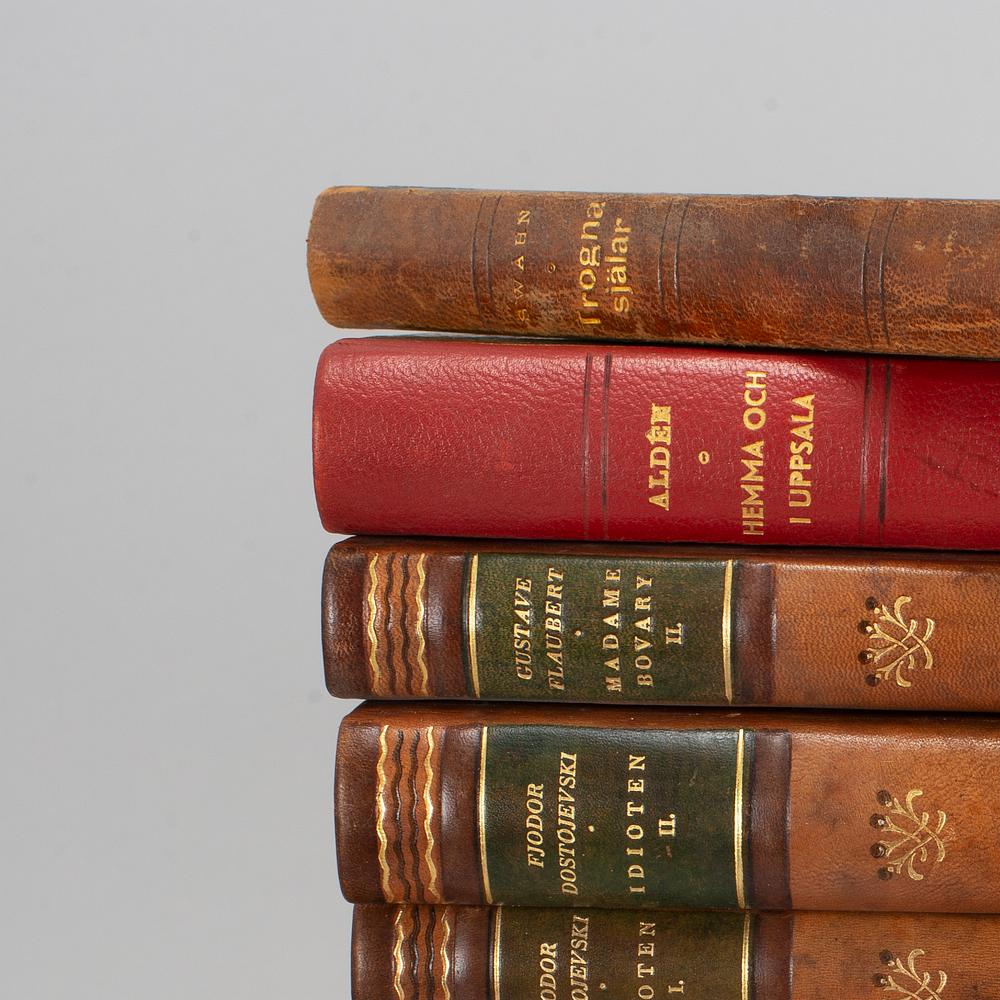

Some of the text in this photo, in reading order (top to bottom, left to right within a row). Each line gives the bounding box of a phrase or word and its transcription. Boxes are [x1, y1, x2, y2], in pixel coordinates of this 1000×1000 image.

[604, 217, 634, 313] själar
[740, 370, 768, 536] HEMMA OCH
[788, 393, 816, 508] UPPSALA
[513, 577, 533, 681] GUSTAVE
[545, 567, 565, 690] FLAUBERT
[602, 569, 622, 692] MADAME
[634, 575, 653, 687] BOVARY
[526, 783, 546, 869] FJODOR
[556, 751, 579, 896] DOSTOJEVSKI
[626, 754, 646, 894] IDIOTEN
